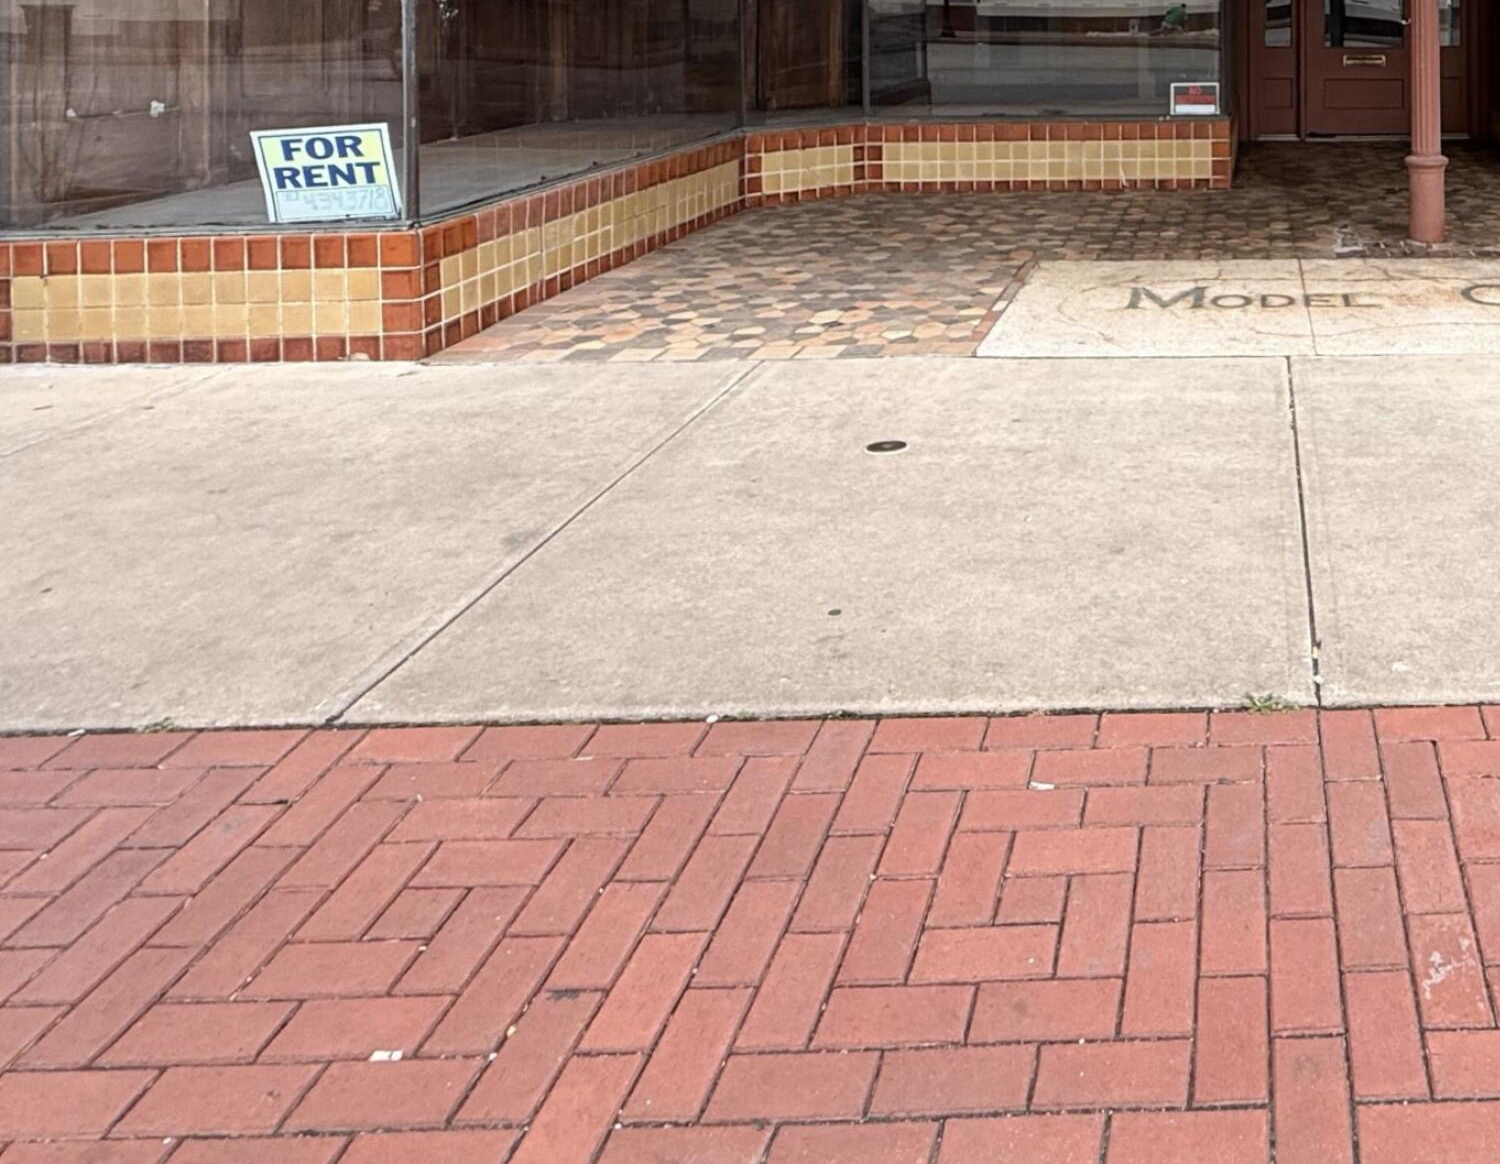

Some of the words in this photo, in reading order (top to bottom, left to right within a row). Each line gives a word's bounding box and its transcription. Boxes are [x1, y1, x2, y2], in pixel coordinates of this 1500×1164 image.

[280, 135, 364, 162] FOR
[273, 161, 381, 190] RENT
[1124, 286, 1383, 309] MODEL
